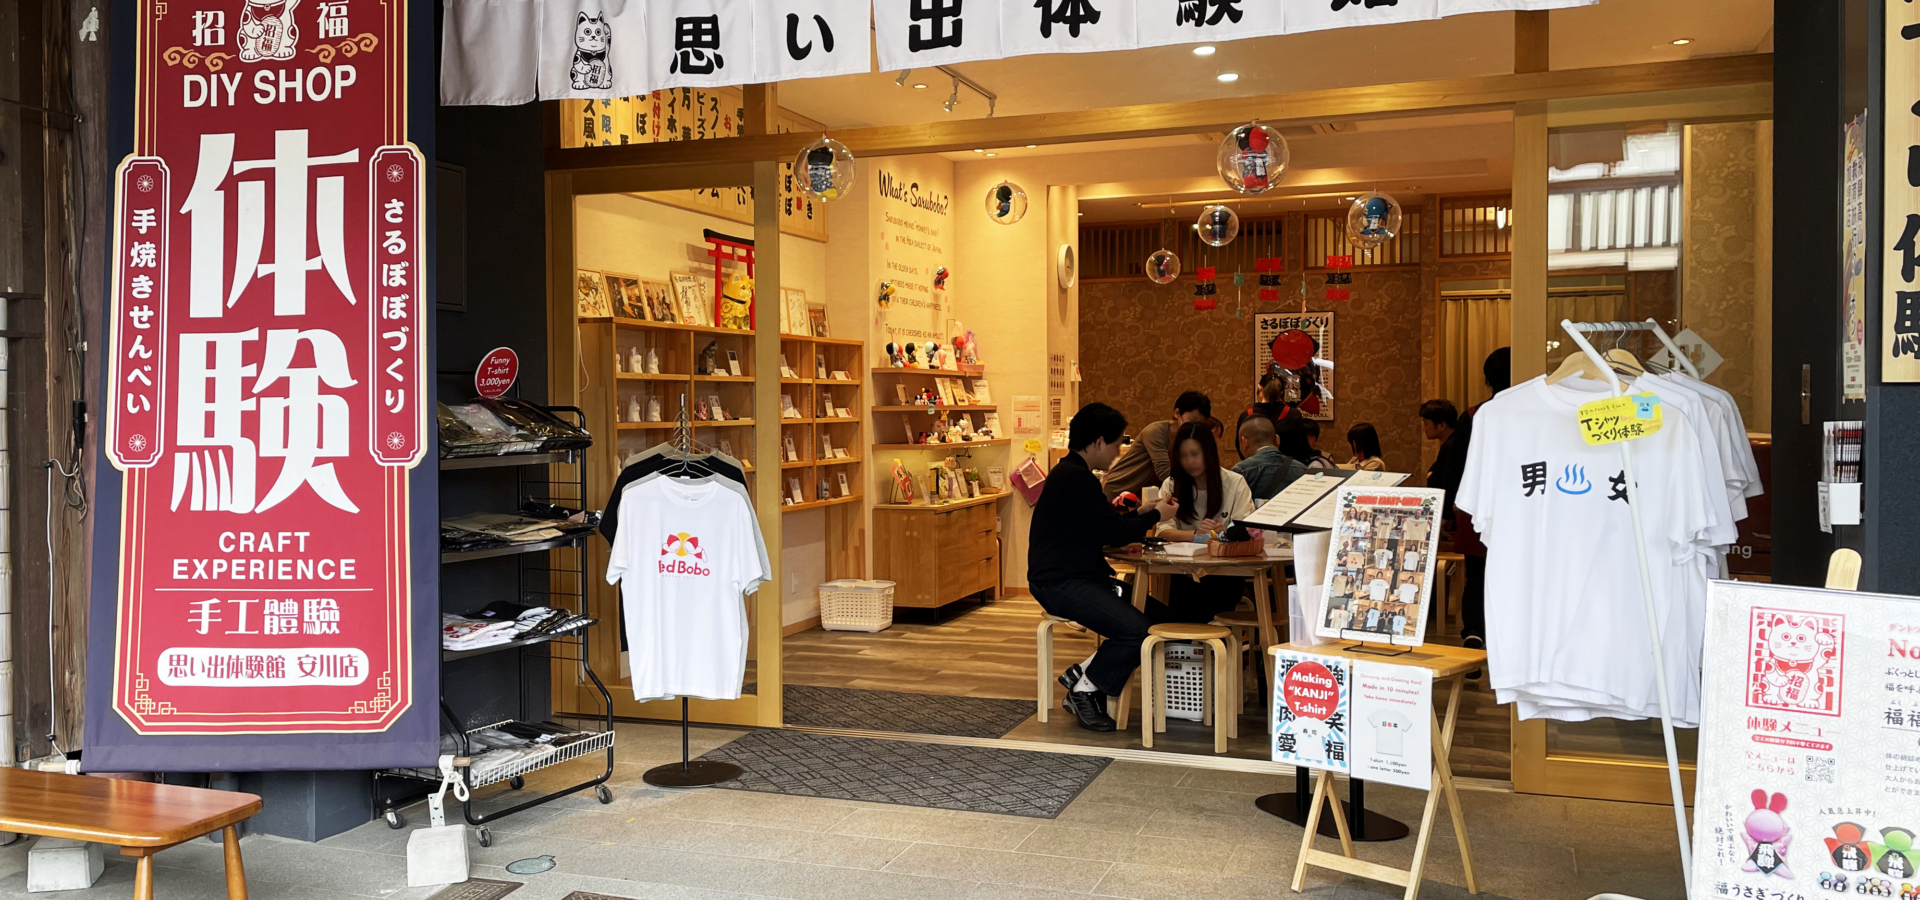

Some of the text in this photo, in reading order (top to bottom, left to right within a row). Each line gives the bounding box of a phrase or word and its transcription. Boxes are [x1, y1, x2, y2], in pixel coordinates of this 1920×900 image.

[192, 1, 349, 47] 招 福
[183, 65, 357, 108] DIY SHOP
[879, 168, 949, 216] What's Sarubobo?
[127, 207, 158, 414] 手焼きせんべい
[381, 198, 409, 414] さるぼぼづくり
[171, 129, 361, 513] 体験
[487, 366, 509, 375] T-shirt
[490, 356, 510, 366] Funny
[480, 377, 511, 387] 3,000yen
[218, 531, 311, 554] CRAFT
[1730, 545, 1752, 559] ng
[172, 558, 357, 581] EXPERIENCE
[677, 560, 711, 577] Bobo
[187, 597, 341, 636] 手工體驗
[167, 653, 359, 680] 思い出体験館 安川店
[1291, 671, 1333, 688] Making
[1785, 674, 1805, 701] 招福
[1294, 702, 1327, 715] T-shirt
[1747, 715, 1840, 737] 体験メニュー
[1278, 732, 1297, 754] 愛
[1325, 740, 1345, 761] 福
